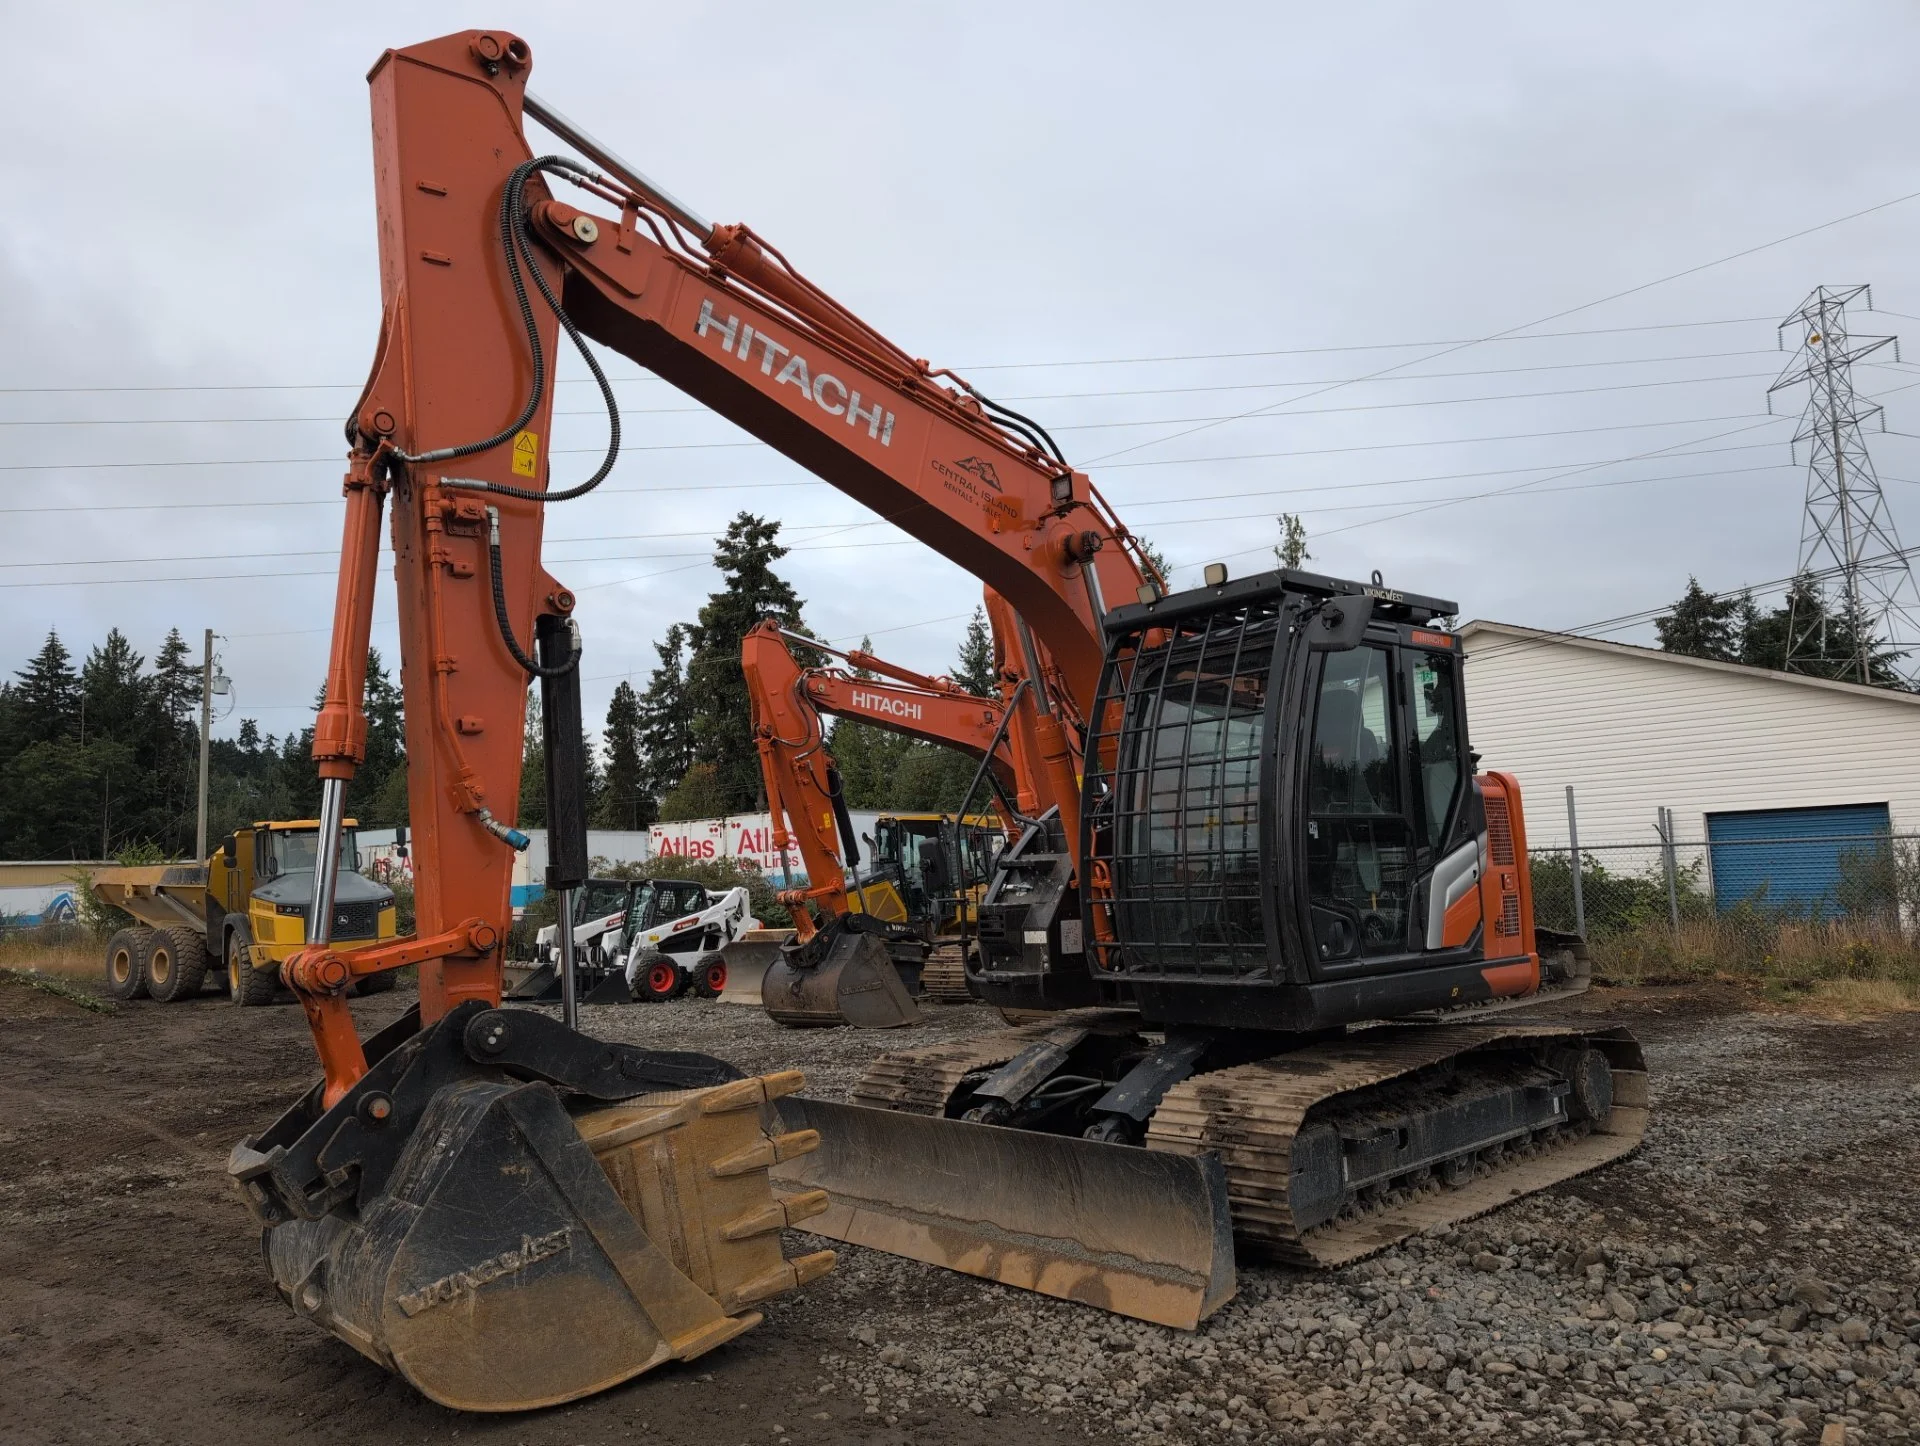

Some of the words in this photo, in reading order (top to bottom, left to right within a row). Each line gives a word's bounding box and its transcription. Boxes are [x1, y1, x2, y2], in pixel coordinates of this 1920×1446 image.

[698, 298, 895, 447] HITACHI
[931, 460, 978, 495] CENTRAL
[981, 490, 1018, 518] ISLAND
[943, 480, 973, 504] RENTALS
[852, 690, 922, 720] HITACHI
[659, 836, 715, 859] Atlas
[737, 827, 800, 854] Atls
